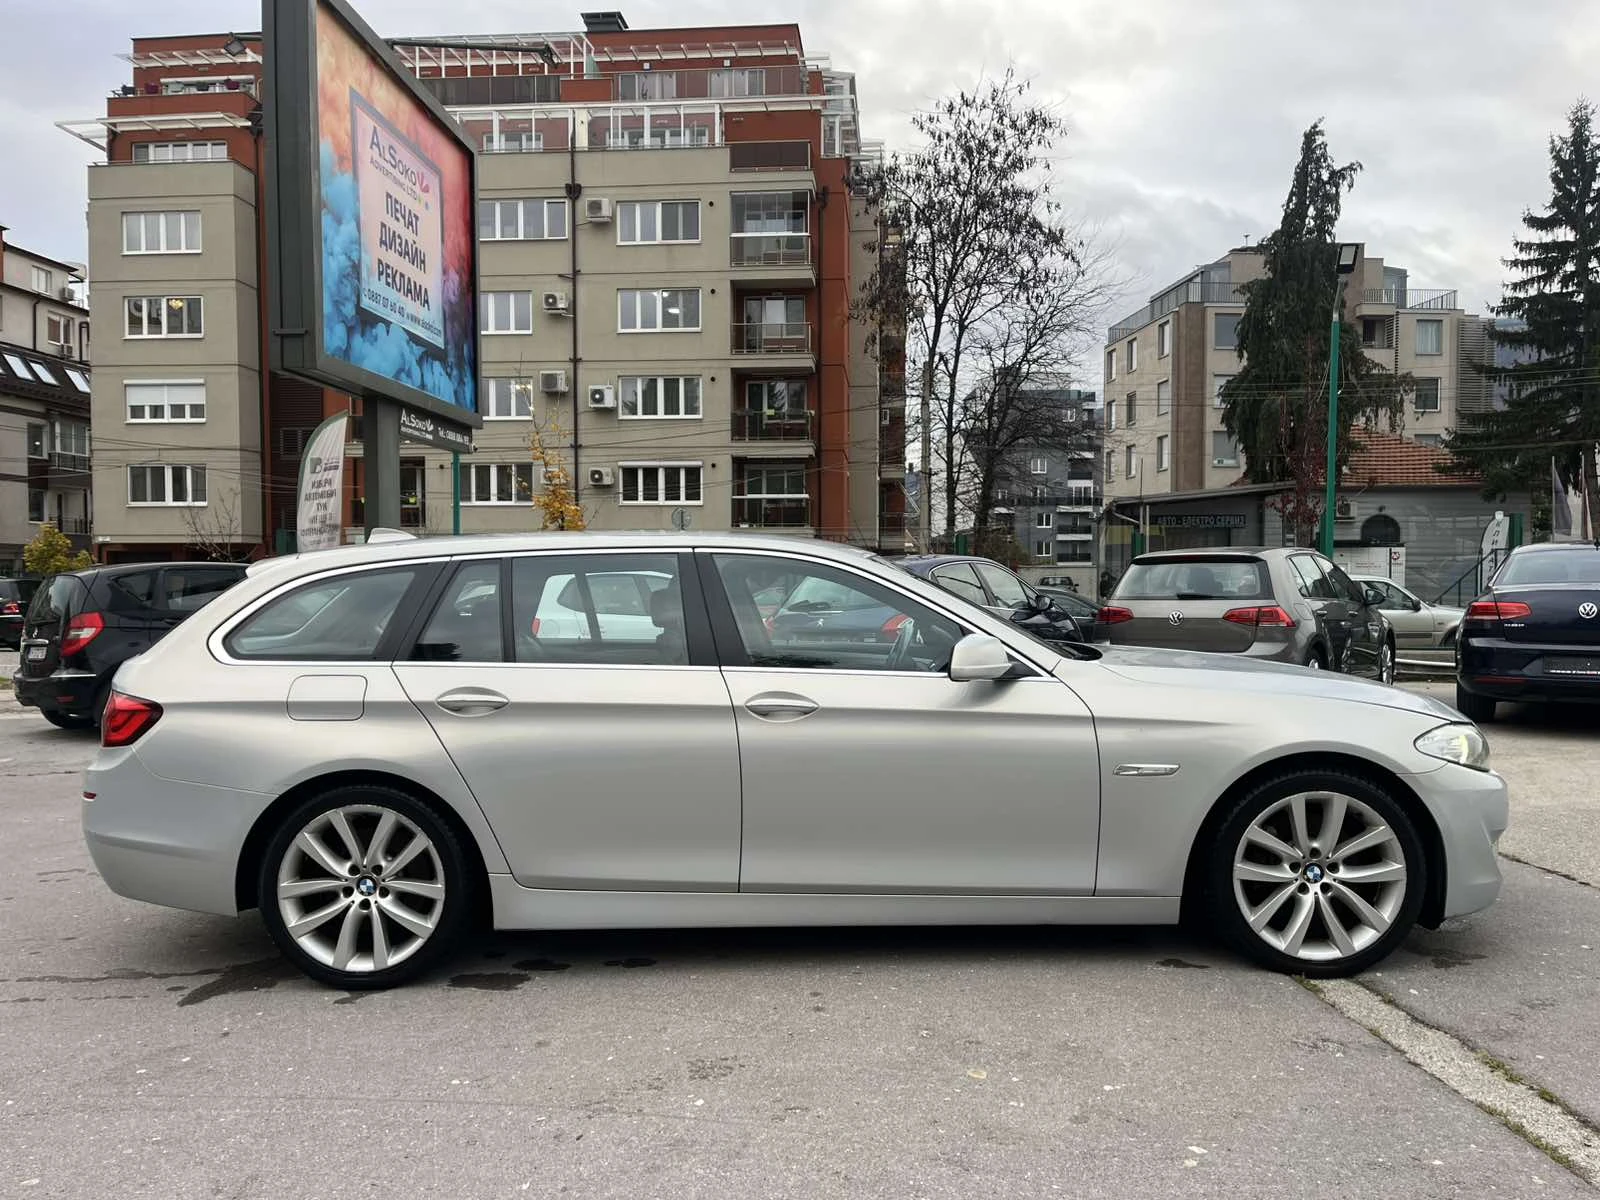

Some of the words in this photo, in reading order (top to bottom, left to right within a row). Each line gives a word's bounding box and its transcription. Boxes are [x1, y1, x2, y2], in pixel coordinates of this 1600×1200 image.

[385, 191, 420, 237] ПЕЧАТ
[379, 221, 427, 274] ДИЗАЙН
[377, 257, 431, 312] РЕКЛАМА
